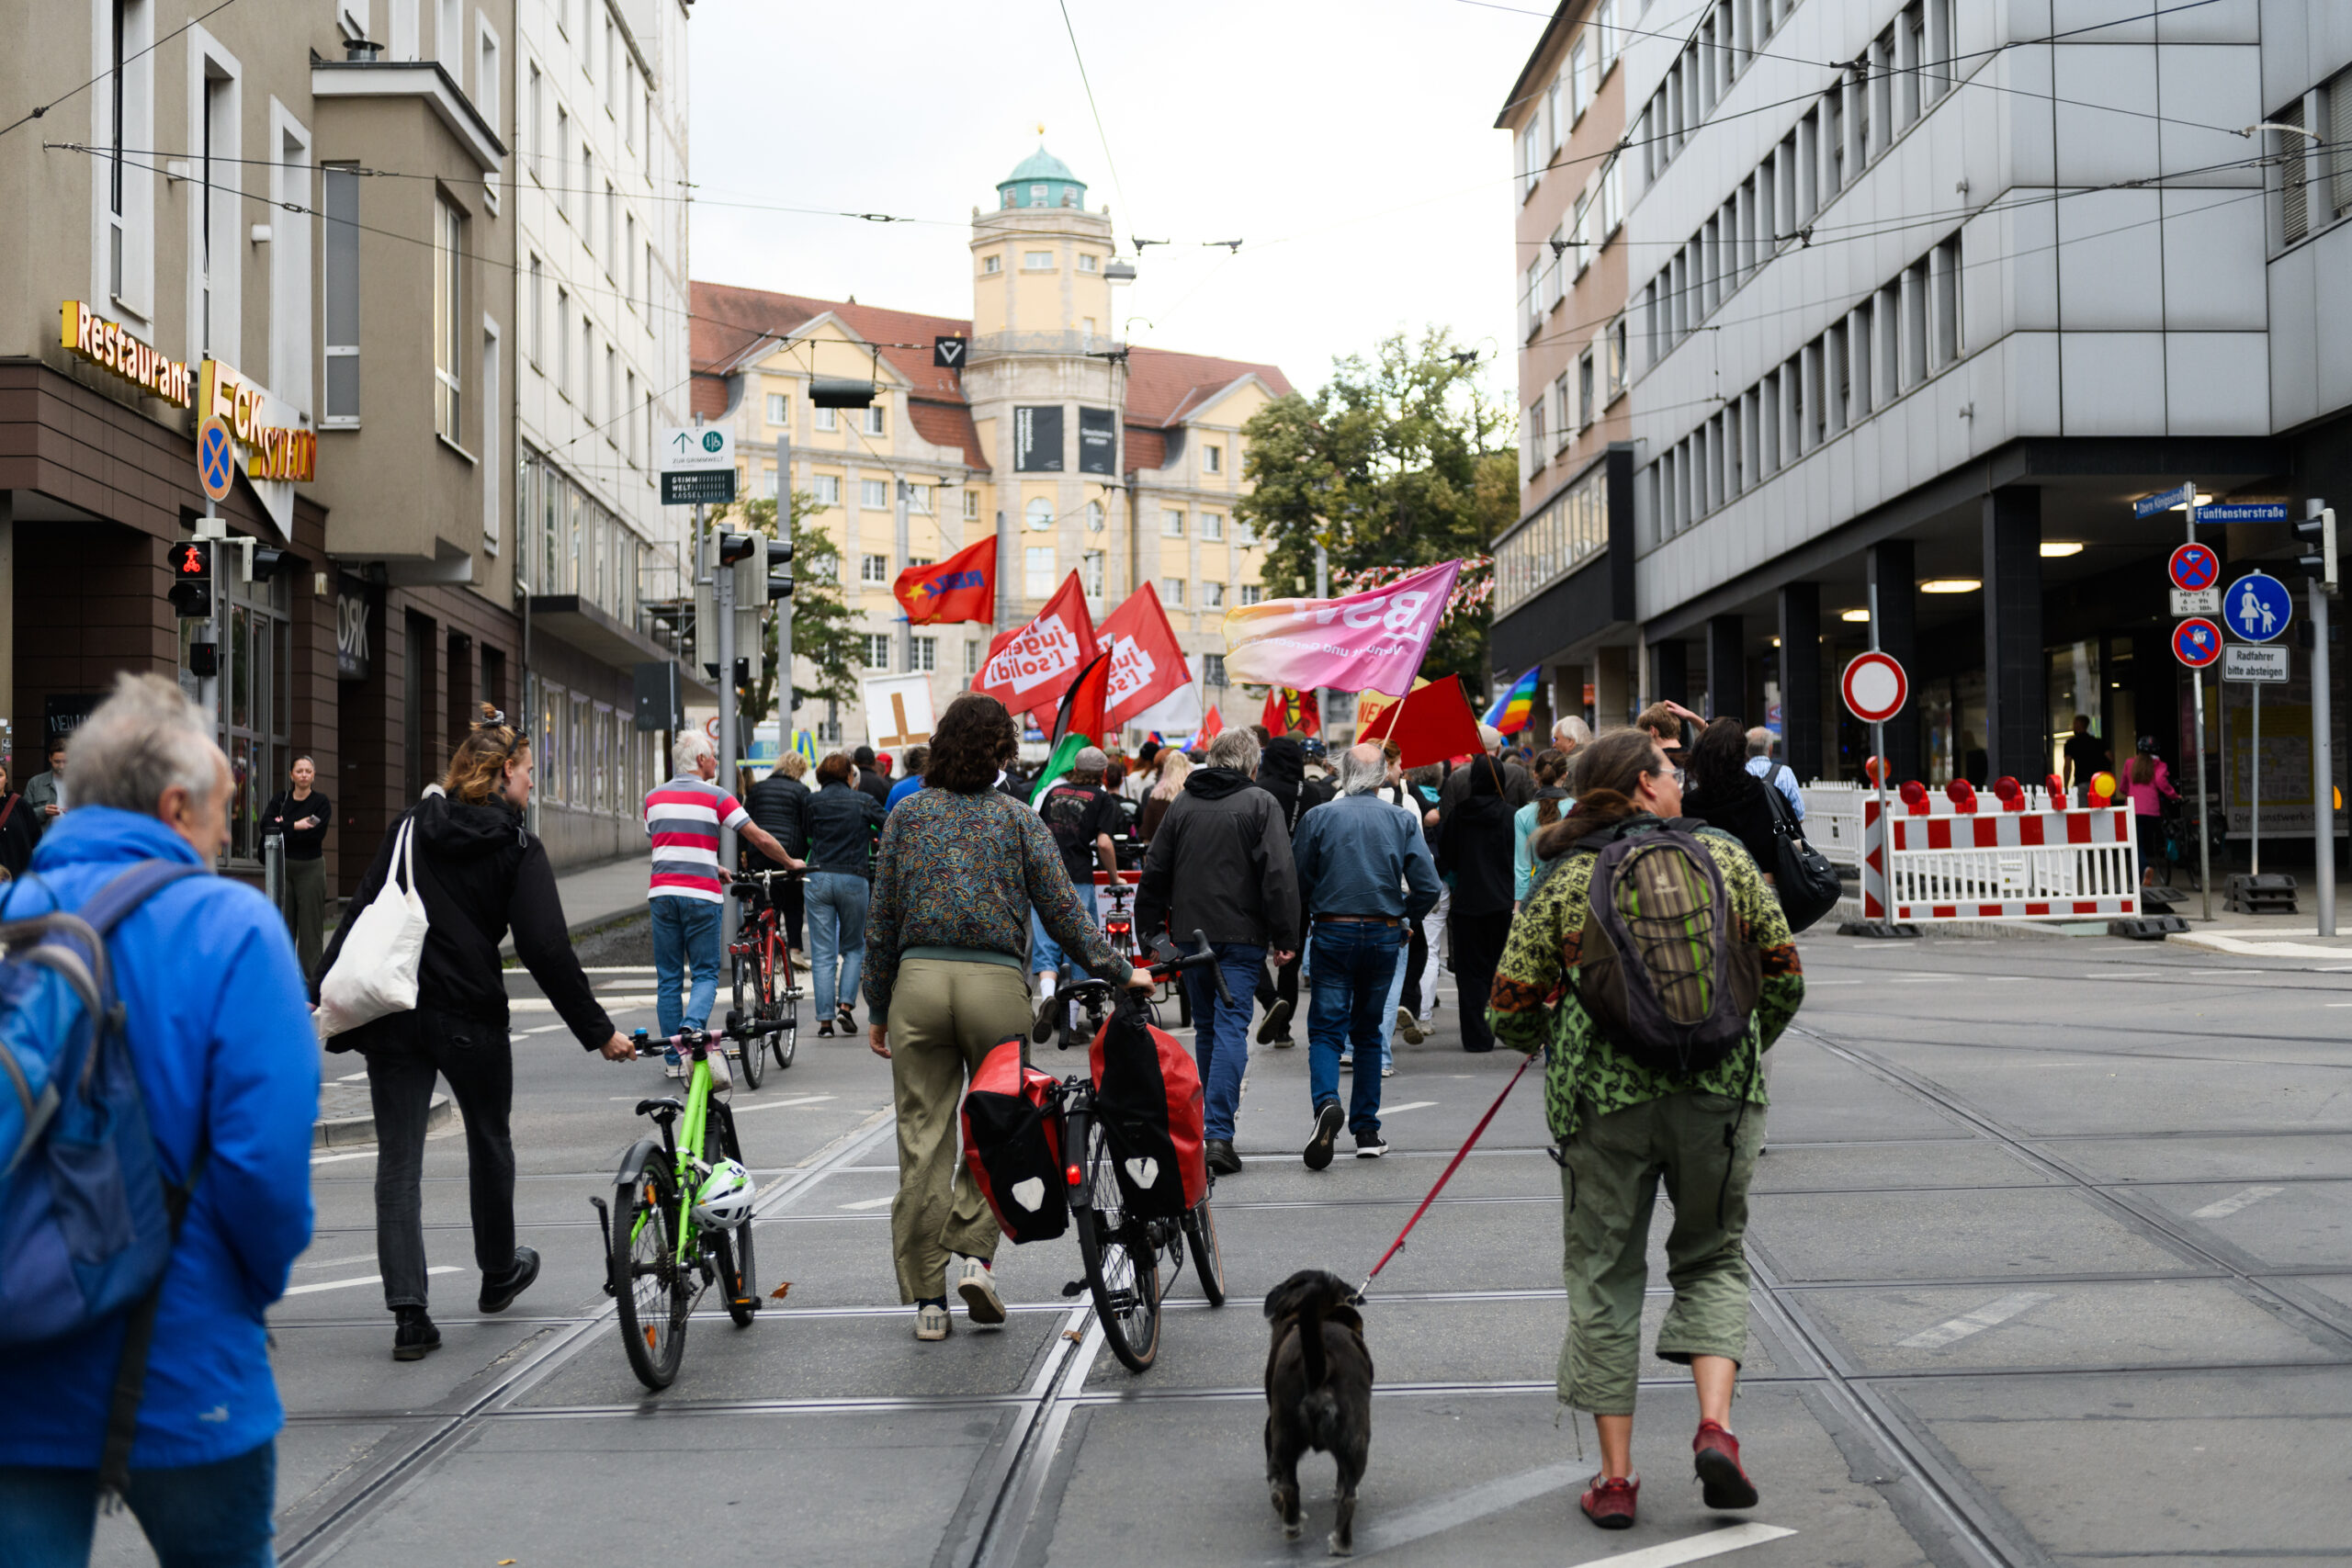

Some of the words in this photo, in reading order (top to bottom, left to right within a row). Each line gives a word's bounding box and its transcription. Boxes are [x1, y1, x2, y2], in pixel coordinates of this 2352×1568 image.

[77, 300, 191, 409] Restaurant
[672, 483, 691, 491] WELT
[672, 491, 702, 500] KASSEL
[2197, 506, 2285, 520] Fünffensterstraße
[2236, 649, 2275, 661] Radfahrer
[2227, 665, 2245, 676] bitte
[2245, 665, 2283, 678] absteigen
